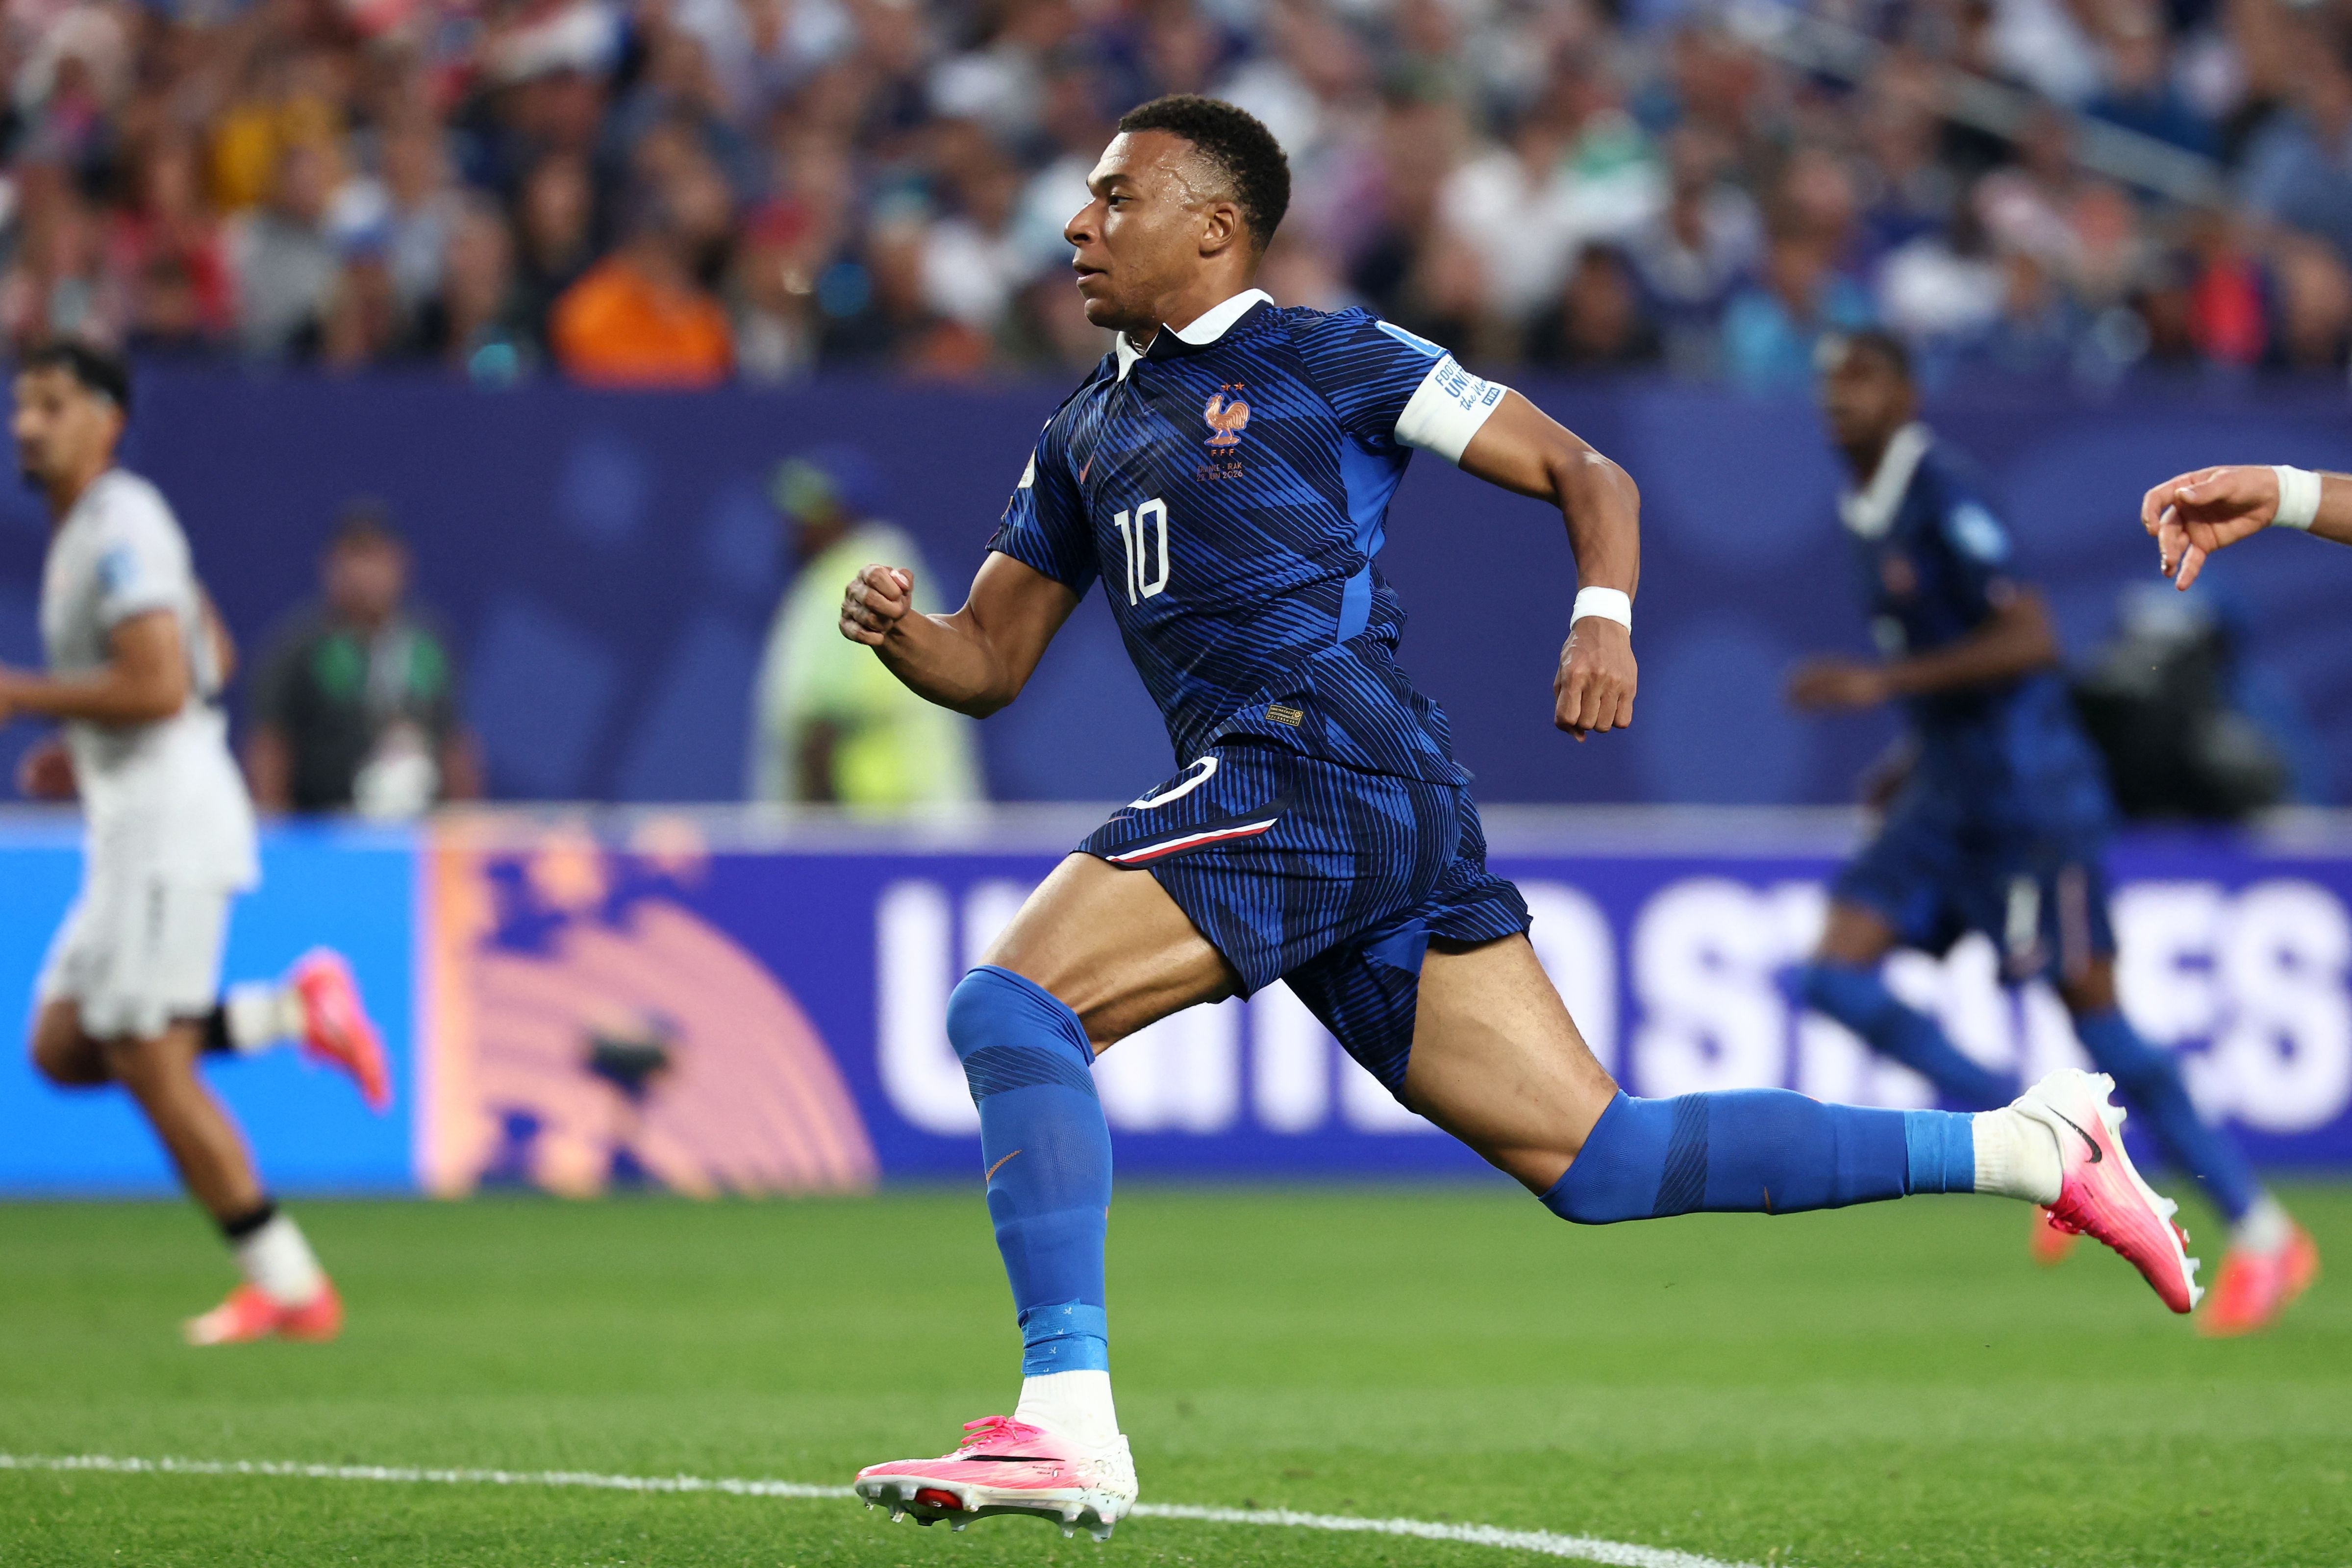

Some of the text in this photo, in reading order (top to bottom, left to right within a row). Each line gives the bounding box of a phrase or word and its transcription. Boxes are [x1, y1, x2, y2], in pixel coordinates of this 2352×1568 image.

[1444, 368, 1474, 398] UNIT
[1459, 394, 1476, 411] the
[1482, 388, 1500, 405] FIFA
[1227, 462, 1243, 470] IRAK
[1196, 470, 1243, 482] 22 JUN 2026
[1114, 497, 1170, 606] 10
[1632, 881, 2351, 1130] SES
